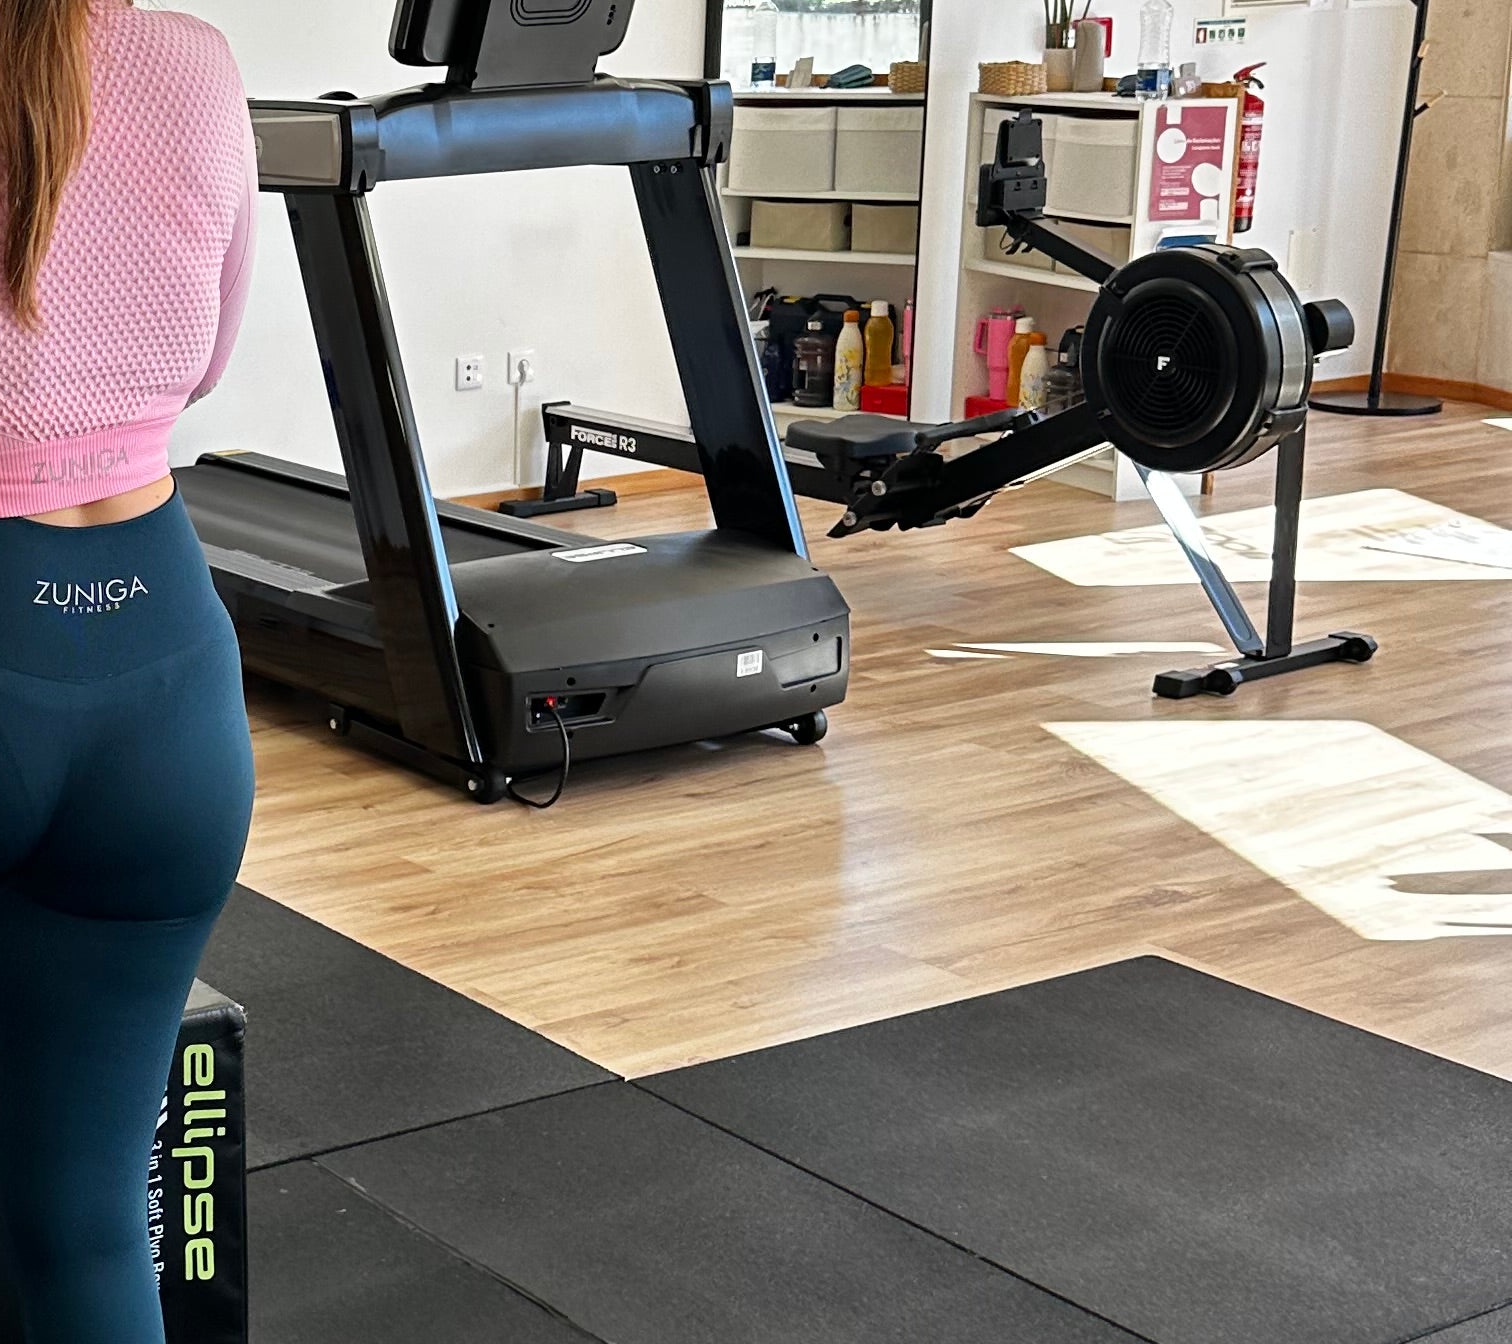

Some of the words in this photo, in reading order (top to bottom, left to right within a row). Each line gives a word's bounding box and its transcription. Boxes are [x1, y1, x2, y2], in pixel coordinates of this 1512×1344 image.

[1157, 356, 1170, 371] F
[619, 435, 637, 453] R3
[32, 446, 130, 485] ZUNIGA
[33, 575, 149, 606] ZUNIGA
[63, 601, 121, 615] FITNESS
[148, 1154, 163, 1172] in
[171, 1043, 227, 1281] ellipse
[147, 1174, 163, 1184] 1
[147, 1188, 164, 1223] Soft
